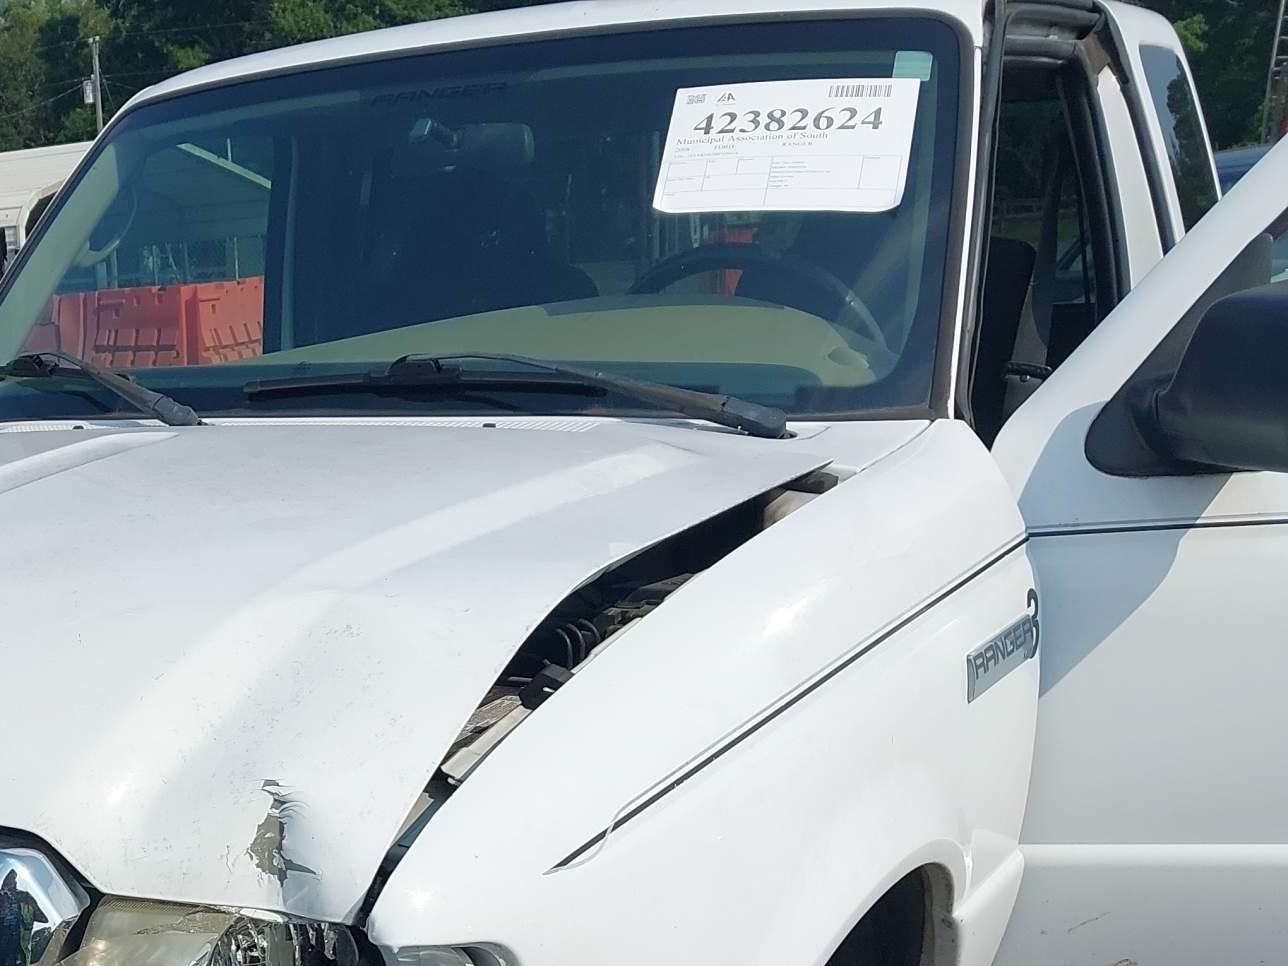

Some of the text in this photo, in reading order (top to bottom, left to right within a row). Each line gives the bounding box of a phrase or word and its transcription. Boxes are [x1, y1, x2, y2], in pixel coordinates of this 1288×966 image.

[693, 106, 883, 135] 42382624
[676, 131, 829, 145] Municipal Association of South
[974, 617, 1034, 680] RANGER
